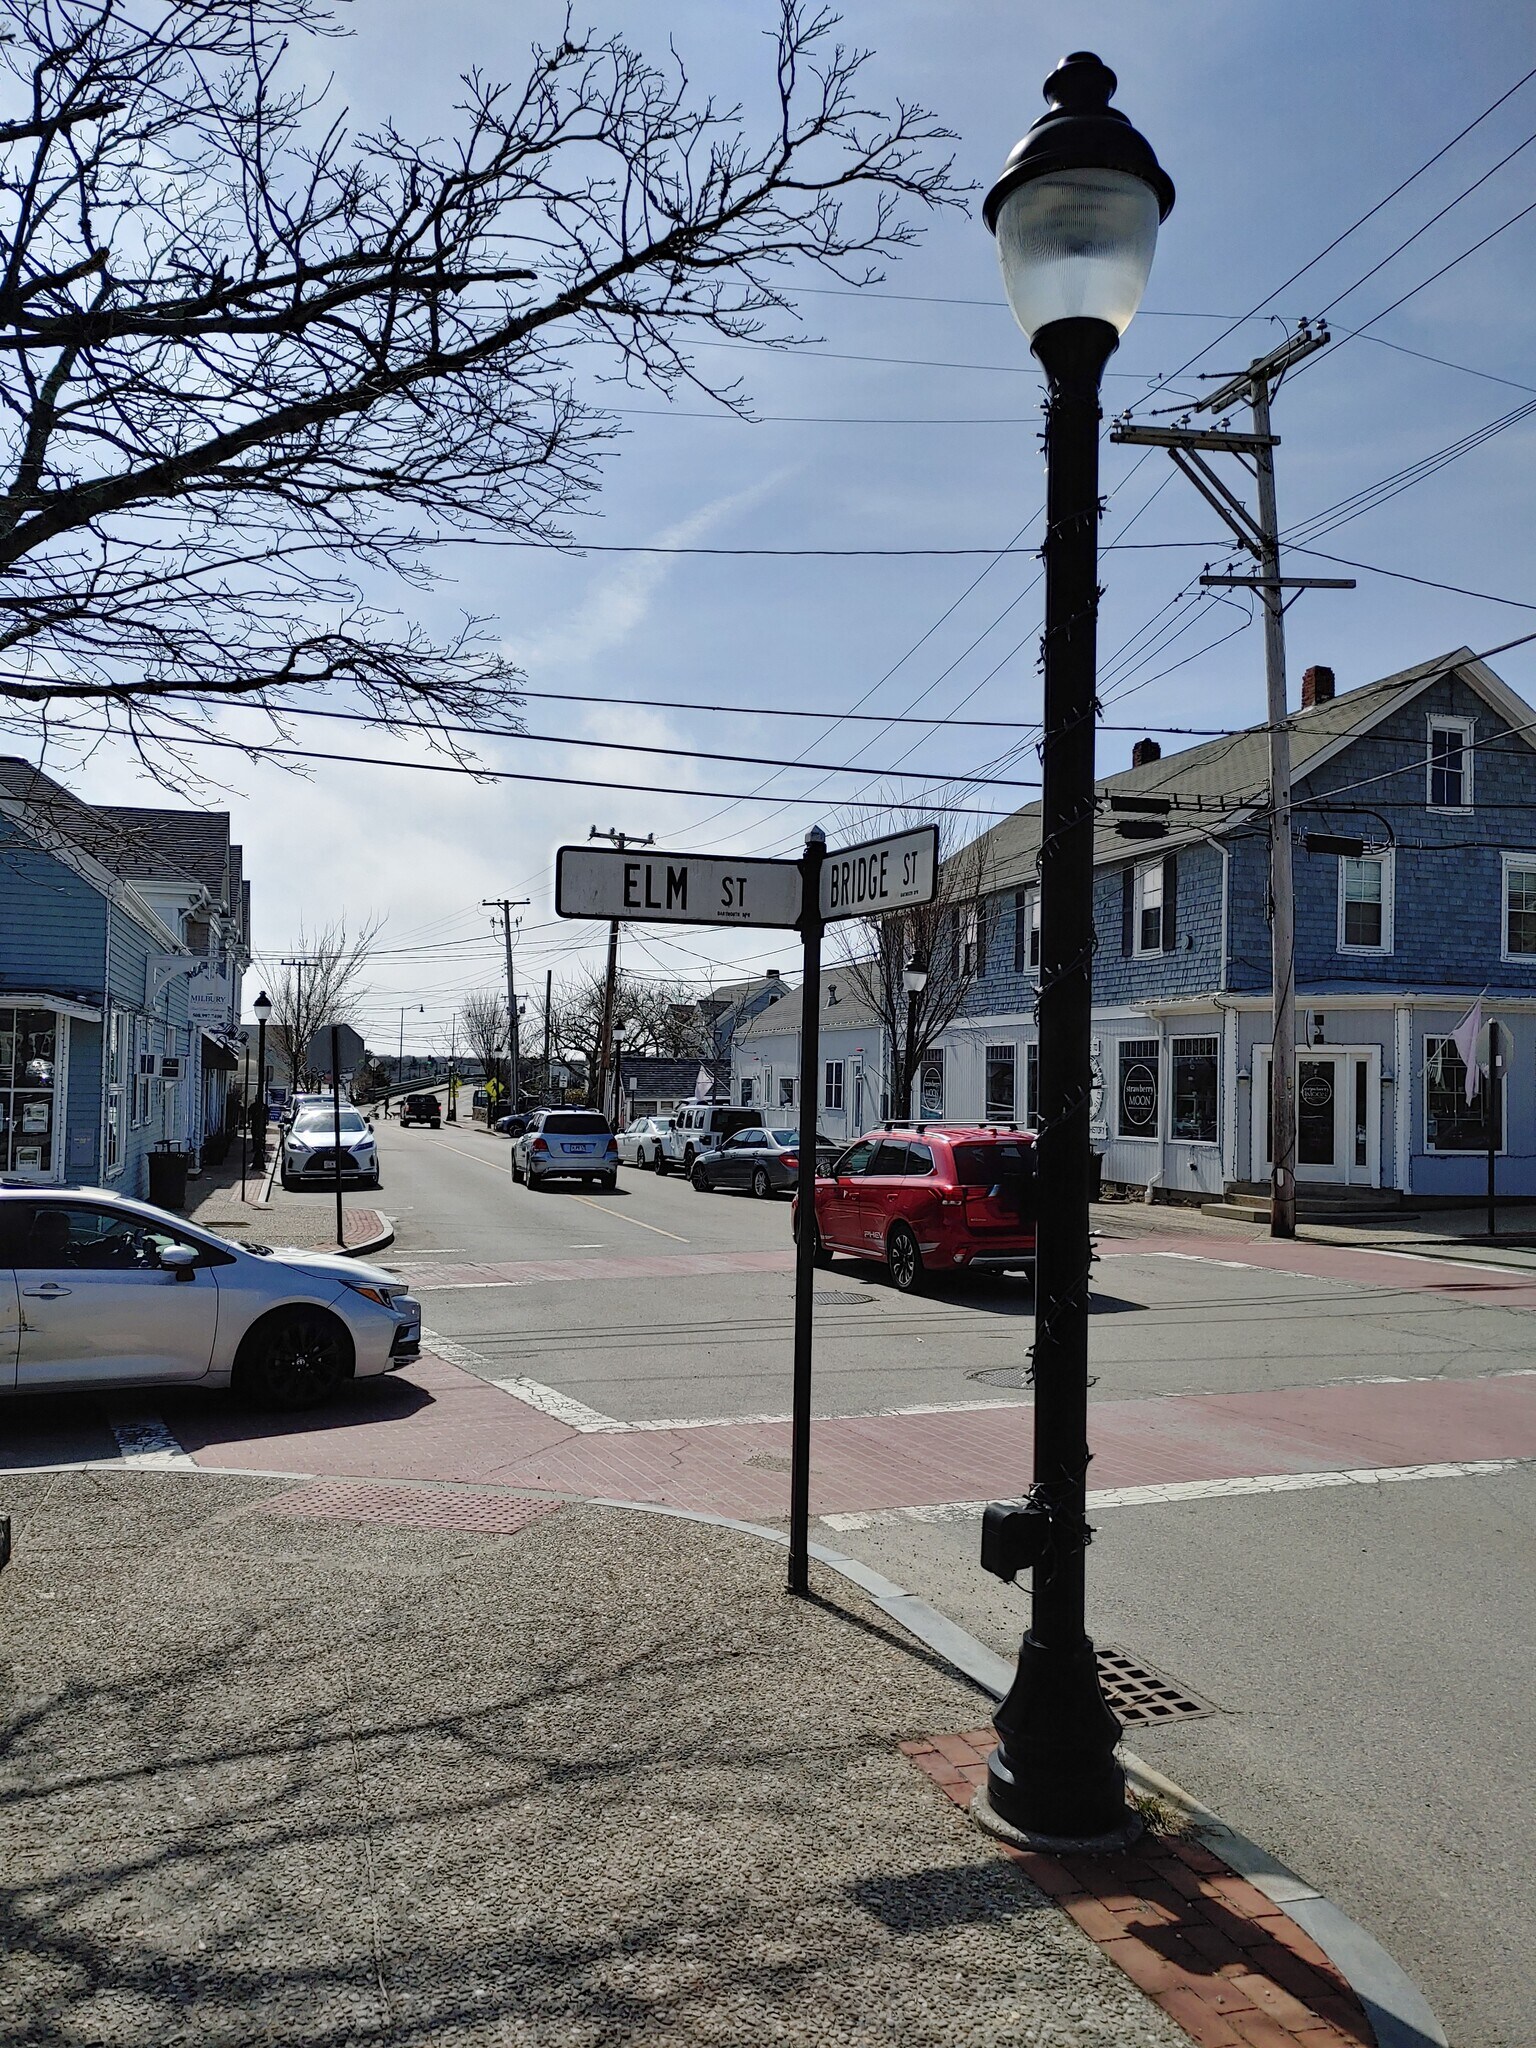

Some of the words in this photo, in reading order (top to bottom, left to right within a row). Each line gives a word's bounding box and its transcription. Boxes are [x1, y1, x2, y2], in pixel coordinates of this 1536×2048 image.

[830, 851, 889, 908] BRIDGE
[903, 850, 918, 885] ST
[624, 863, 688, 910] ELM
[721, 877, 747, 907] ST
[1126, 1084, 1153, 1095] strawberry
[1128, 1095, 1151, 1105] MOON
[864, 1230, 884, 1239] PHEV
